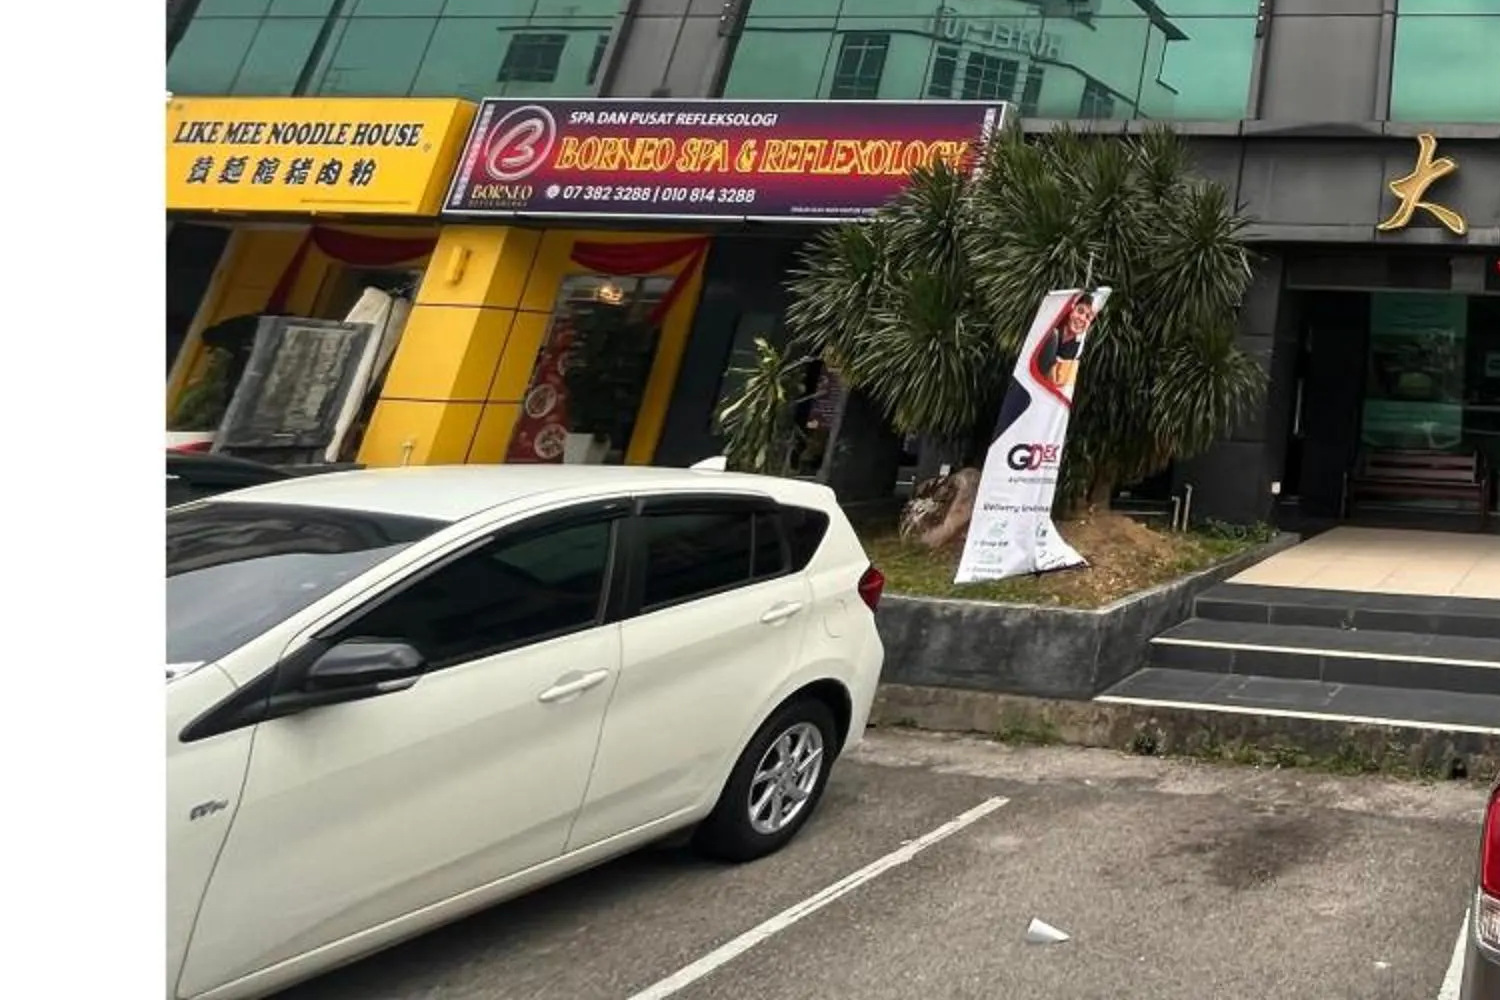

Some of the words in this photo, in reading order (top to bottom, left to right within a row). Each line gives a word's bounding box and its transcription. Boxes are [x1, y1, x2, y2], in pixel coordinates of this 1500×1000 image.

[569, 111, 595, 124] SPA
[597, 112, 628, 125] DAN
[630, 112, 675, 125] PUSAT
[676, 112, 778, 127] REFLEKSOLOGI
[173, 121, 224, 144] LIKE
[221, 122, 267, 145] MEE
[267, 122, 352, 146] NOODLE
[351, 123, 425, 147] HOUSE
[554, 135, 676, 172] BORNEO
[676, 137, 729, 173] SPA
[735, 138, 758, 173] &
[563, 186, 583, 200] 07
[584, 186, 612, 200] 382
[614, 186, 651, 201] 3288
[661, 187, 688, 202] 010
[689, 187, 715, 203] 814
[717, 188, 756, 203] 3288
